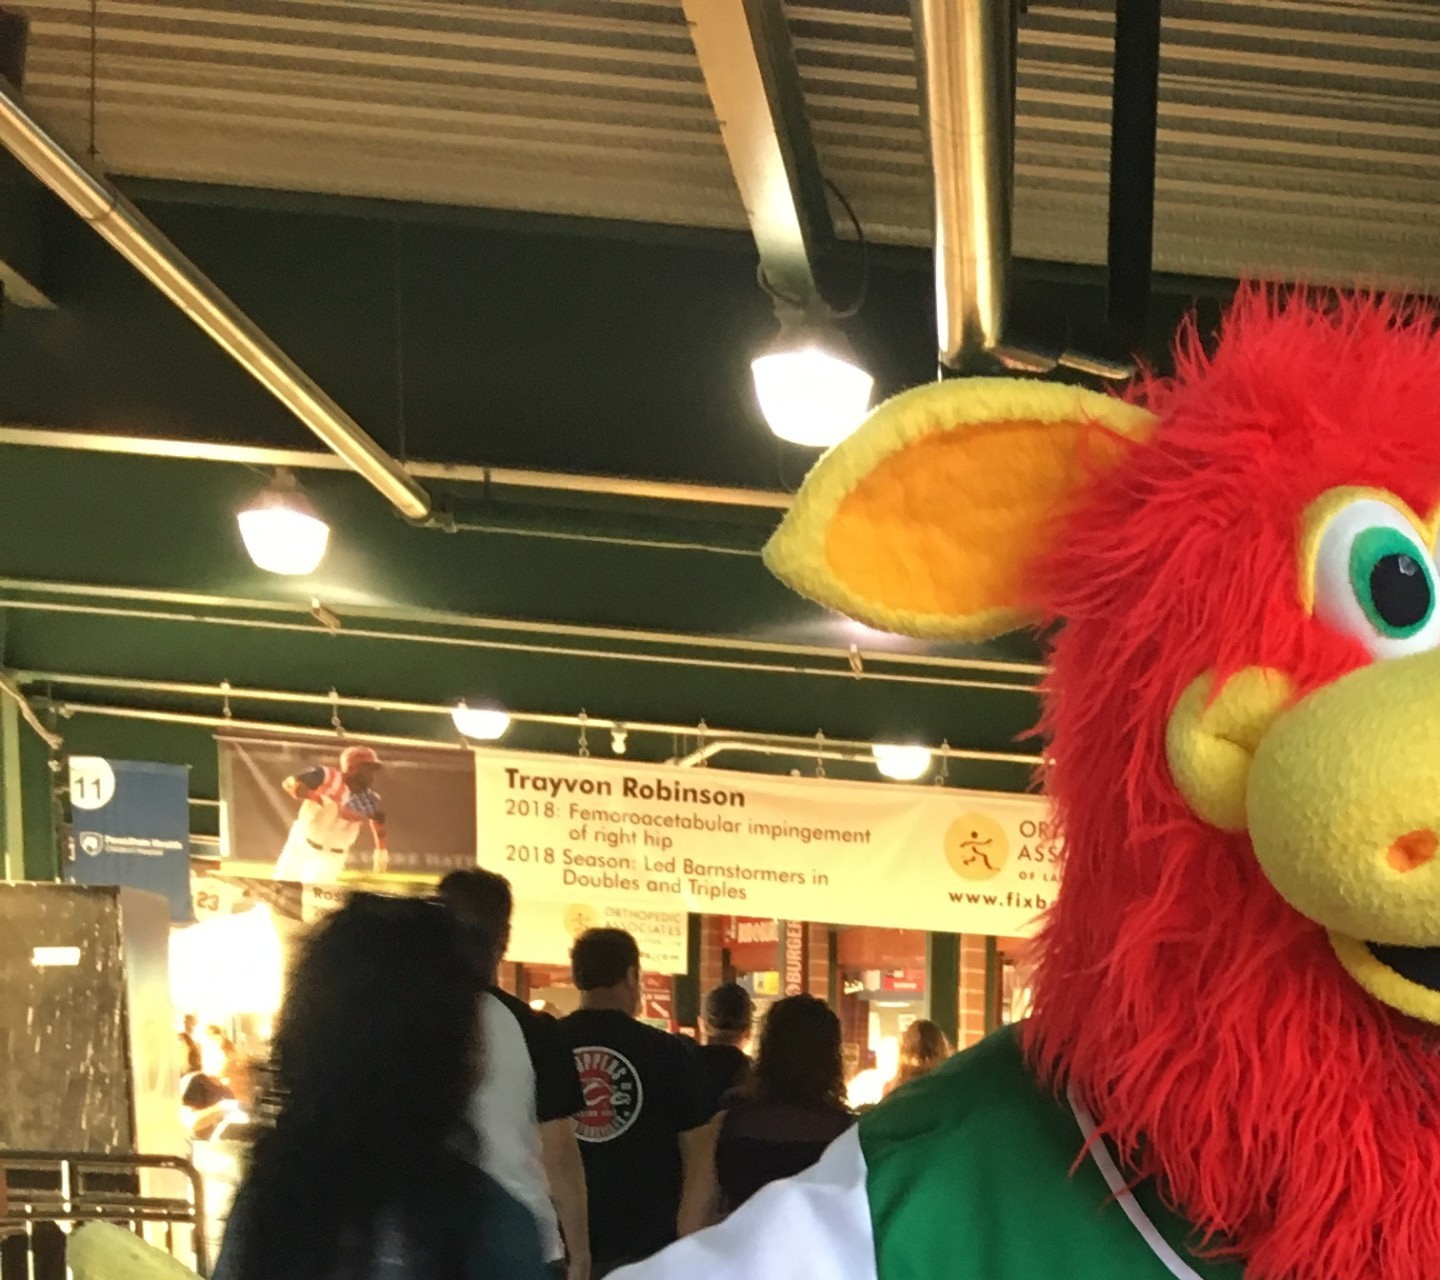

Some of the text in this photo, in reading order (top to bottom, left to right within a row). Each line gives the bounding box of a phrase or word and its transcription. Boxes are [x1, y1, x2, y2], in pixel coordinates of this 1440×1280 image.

[74, 776, 101, 800] 11
[504, 767, 746, 807] Trayvon Robinson
[569, 802, 742, 834] Femoroacetabular
[748, 818, 872, 844] impingement
[569, 824, 673, 852] of right hip
[505, 844, 829, 886] 2018 Season: Led Barnstormers in
[562, 868, 747, 901] Doubles and Triples
[948, 891, 1048, 910] www.fixb
